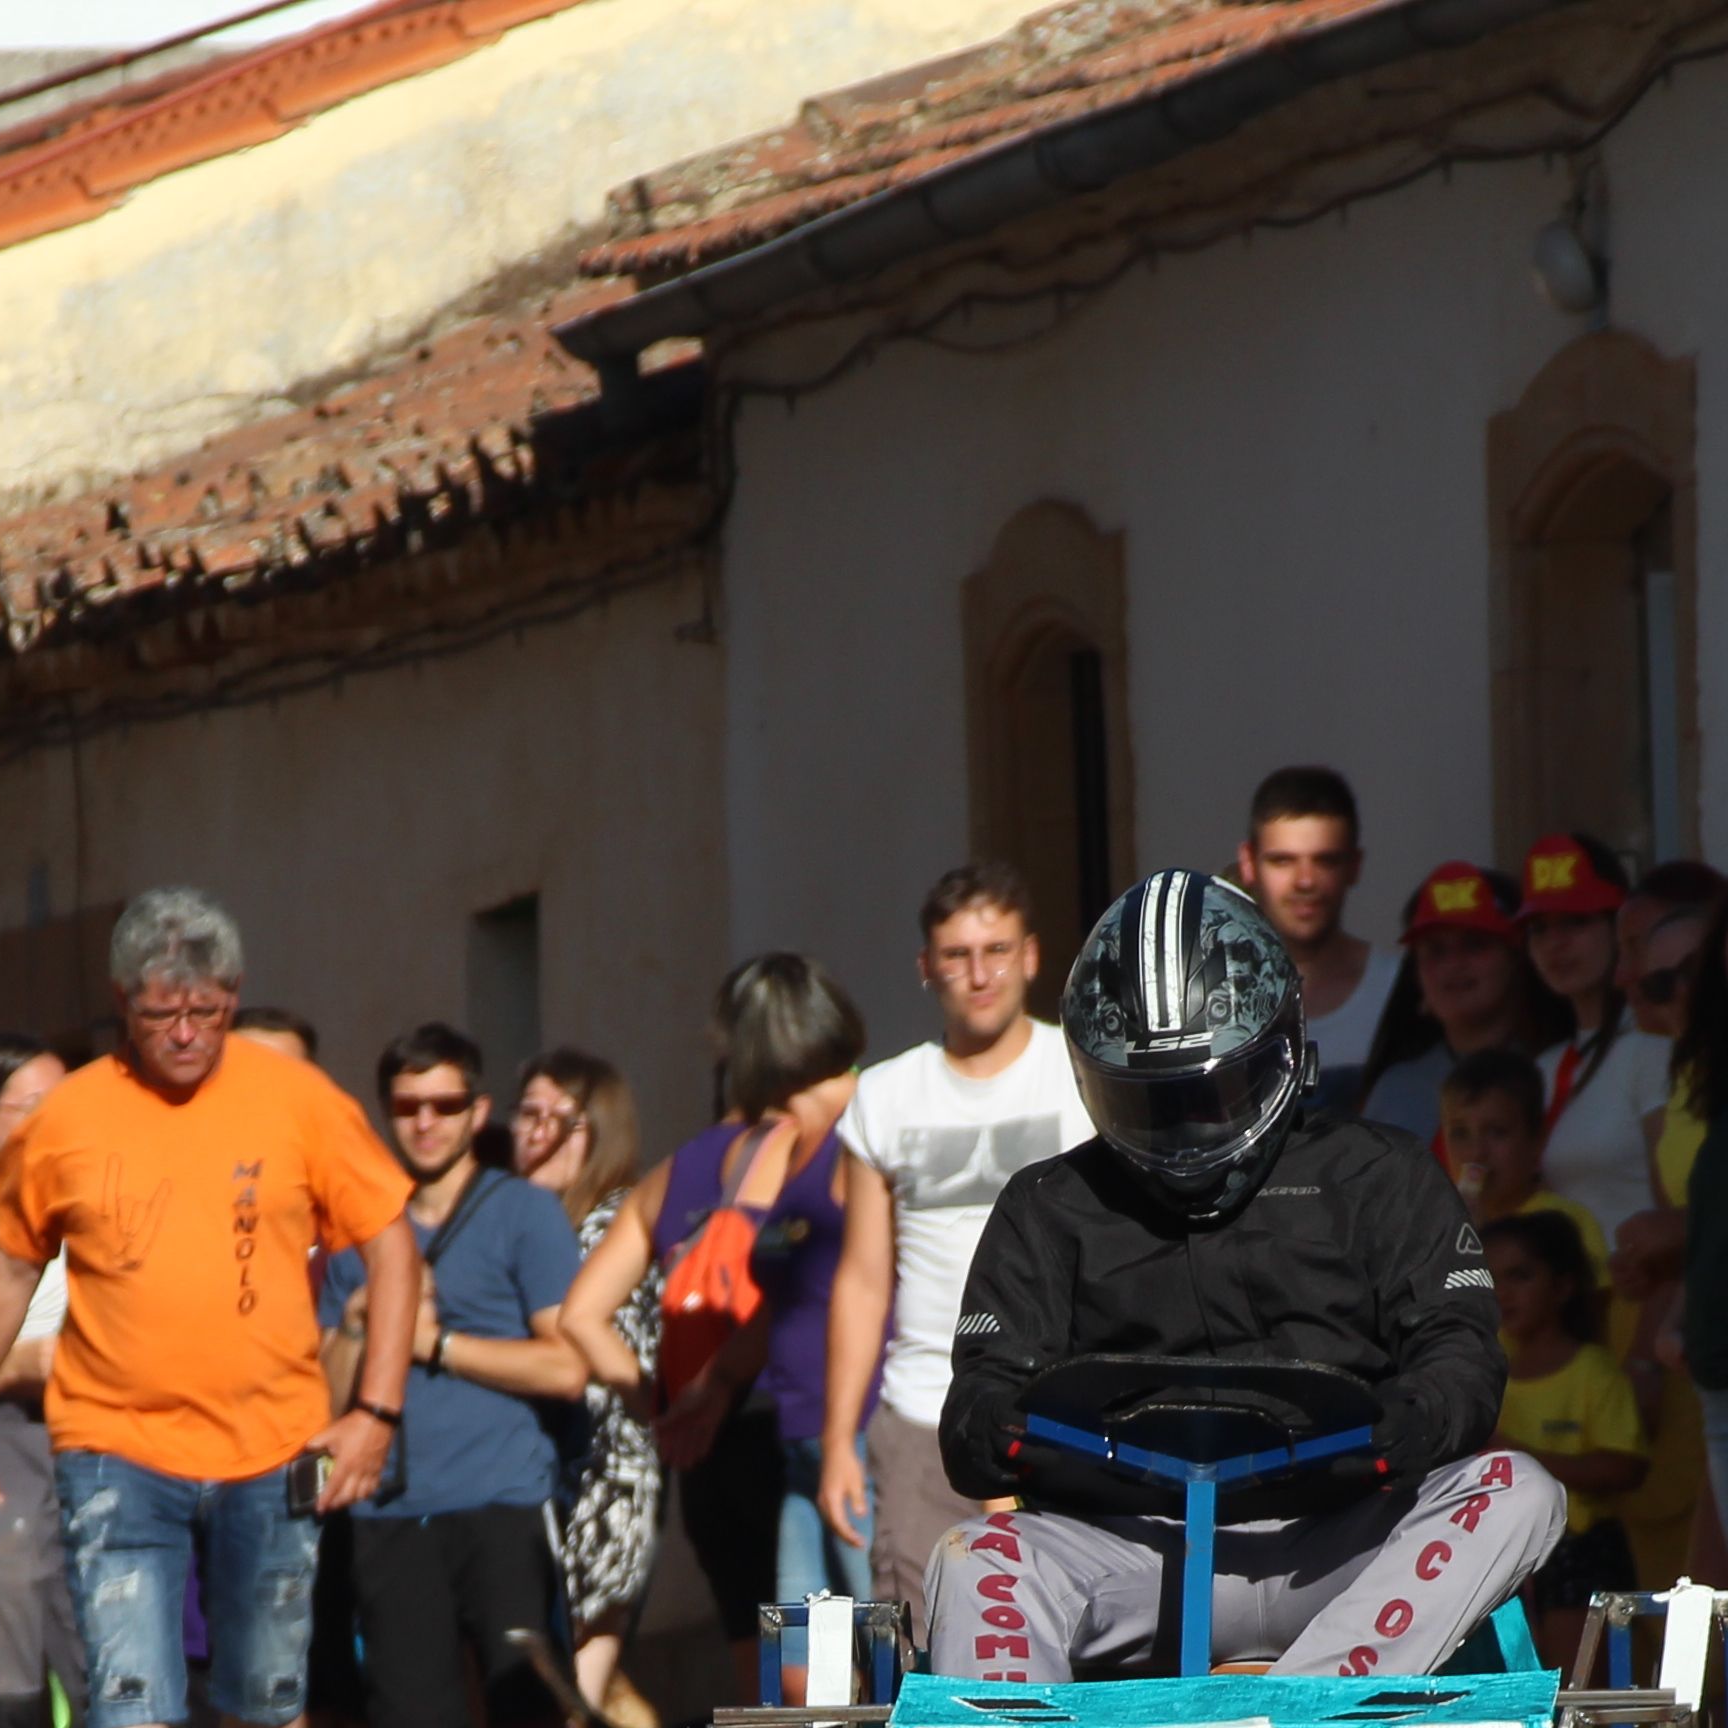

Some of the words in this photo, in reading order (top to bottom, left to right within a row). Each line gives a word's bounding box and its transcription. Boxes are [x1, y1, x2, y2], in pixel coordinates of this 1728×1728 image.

[1123, 1031, 1214, 1054] LS2
[232, 1158, 265, 1318] MANOLO
[1338, 1449, 1514, 1677] ARCOS
